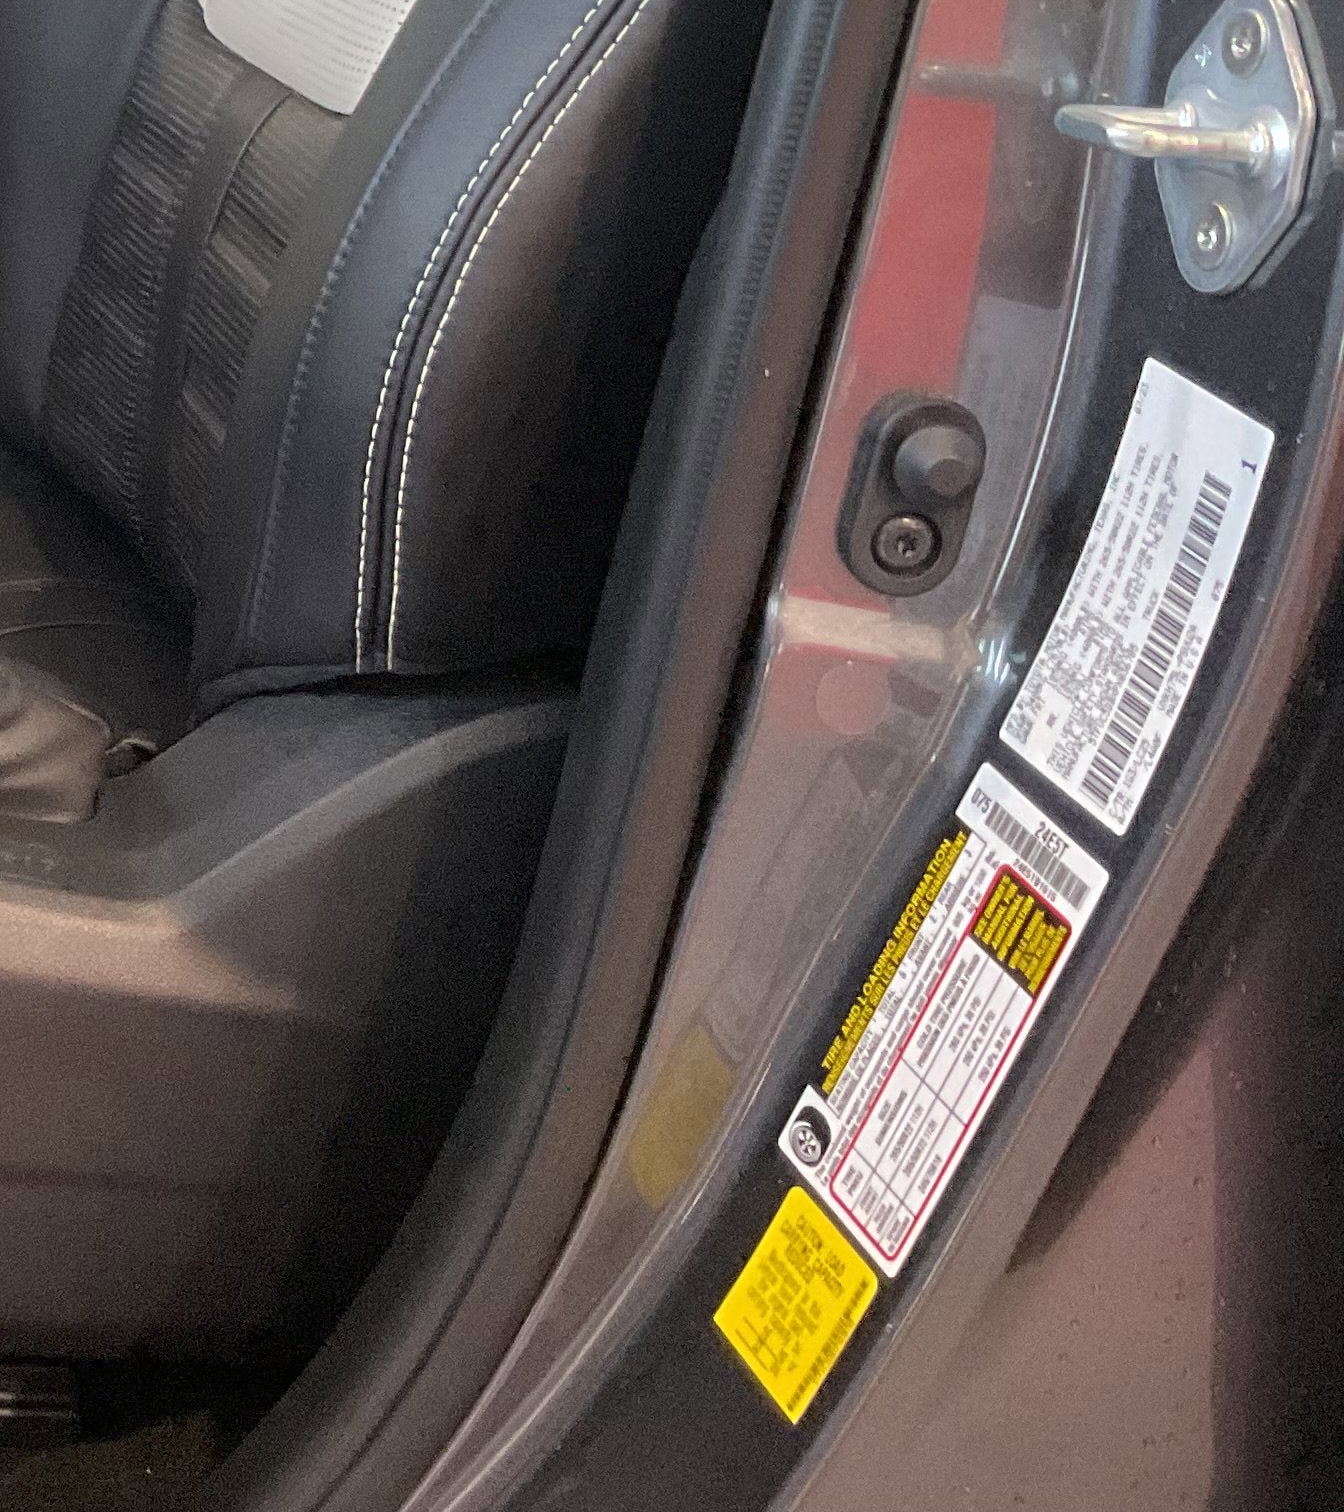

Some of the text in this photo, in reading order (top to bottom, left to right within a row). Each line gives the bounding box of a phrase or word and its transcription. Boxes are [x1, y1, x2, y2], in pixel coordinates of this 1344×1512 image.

[1240, 456, 1258, 475] 1
[970, 785, 993, 813] 075
[1033, 820, 1070, 858] 24E5T
[820, 1034, 844, 1073] TIRE
[838, 1001, 862, 1038] AND
[855, 936, 899, 1006] LOADING
[889, 836, 955, 941] INFORMATION
